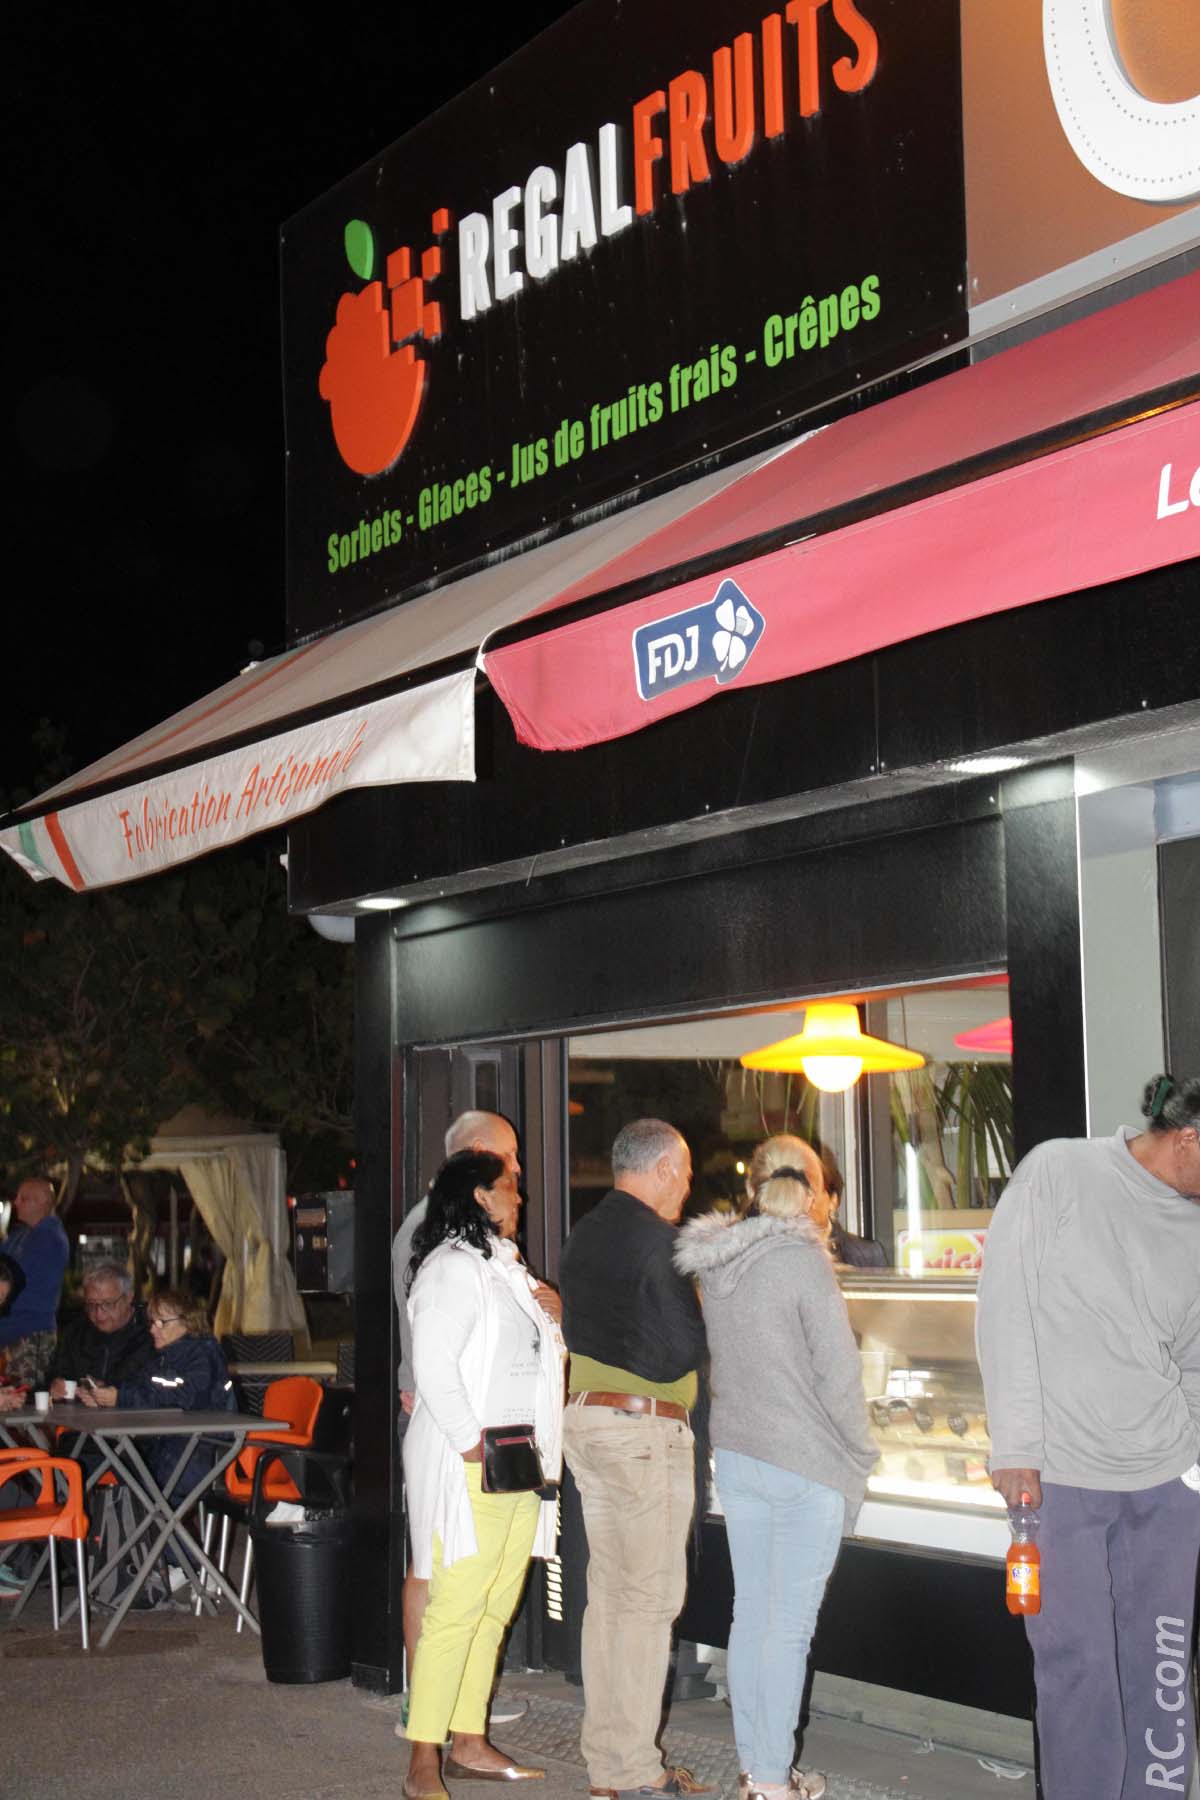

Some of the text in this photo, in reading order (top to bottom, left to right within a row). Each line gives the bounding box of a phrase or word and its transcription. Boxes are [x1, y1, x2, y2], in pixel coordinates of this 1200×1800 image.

[458, 122, 633, 321] REGAL
[633, 0, 879, 216] FRUITS
[327, 509, 402, 573] Sorbets
[418, 465, 492, 531] Glaces
[510, 437, 549, 488] Jus
[554, 419, 585, 468] de
[589, 381, 664, 451] fruits
[668, 343, 738, 413] frais
[763, 274, 881, 368] Crêpes
[647, 624, 699, 685] FDJ
[118, 719, 368, 860] Fabrication Artisanale
